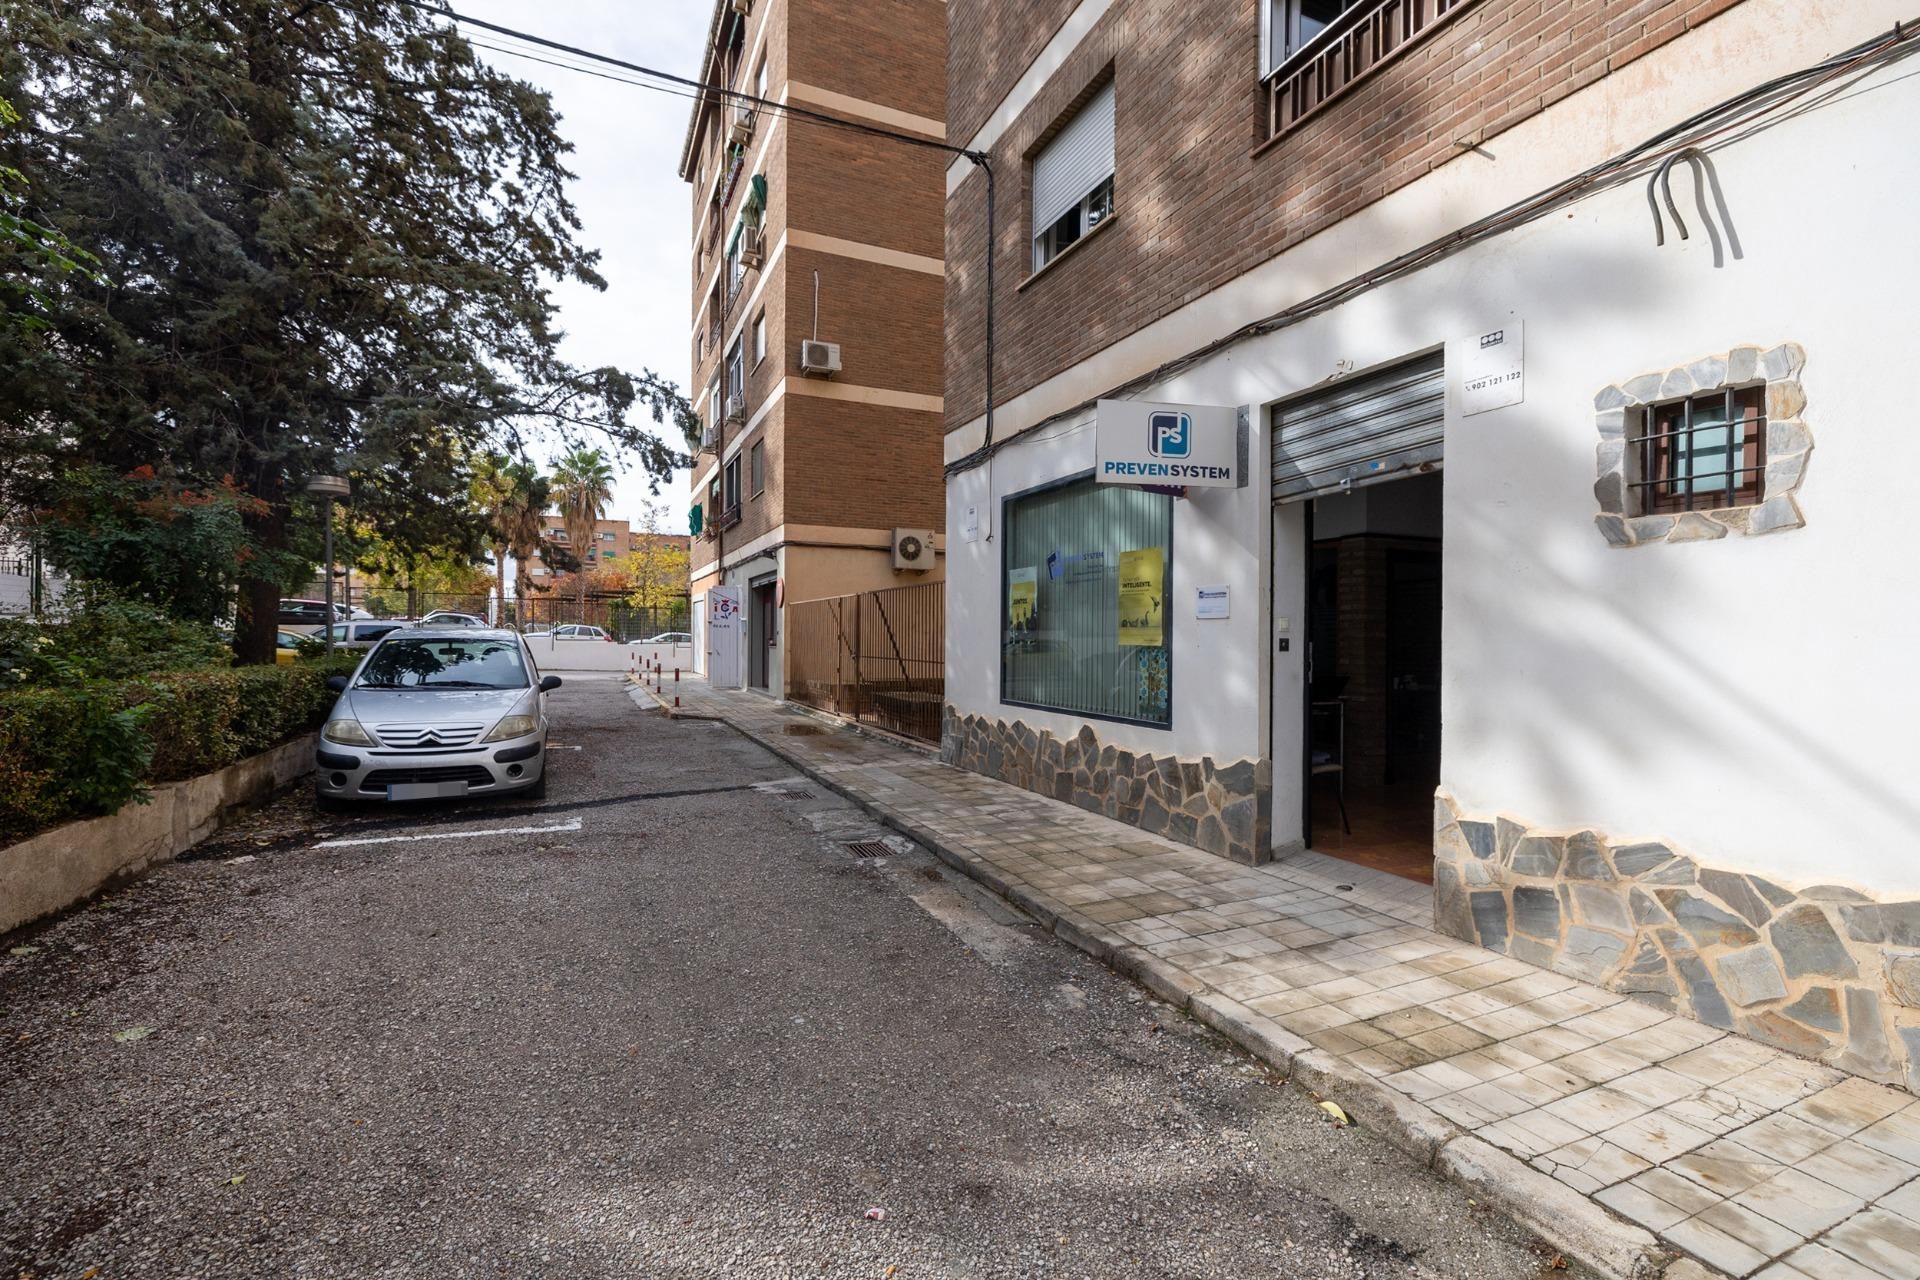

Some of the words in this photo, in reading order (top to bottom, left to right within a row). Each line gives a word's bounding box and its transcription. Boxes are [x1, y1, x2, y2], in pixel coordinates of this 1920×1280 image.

[1471, 380, 1486, 390] 902
[1489, 376, 1502, 386] 121
[1506, 371, 1521, 382] 122
[1104, 461, 1230, 480] PREVENSYSTEM
